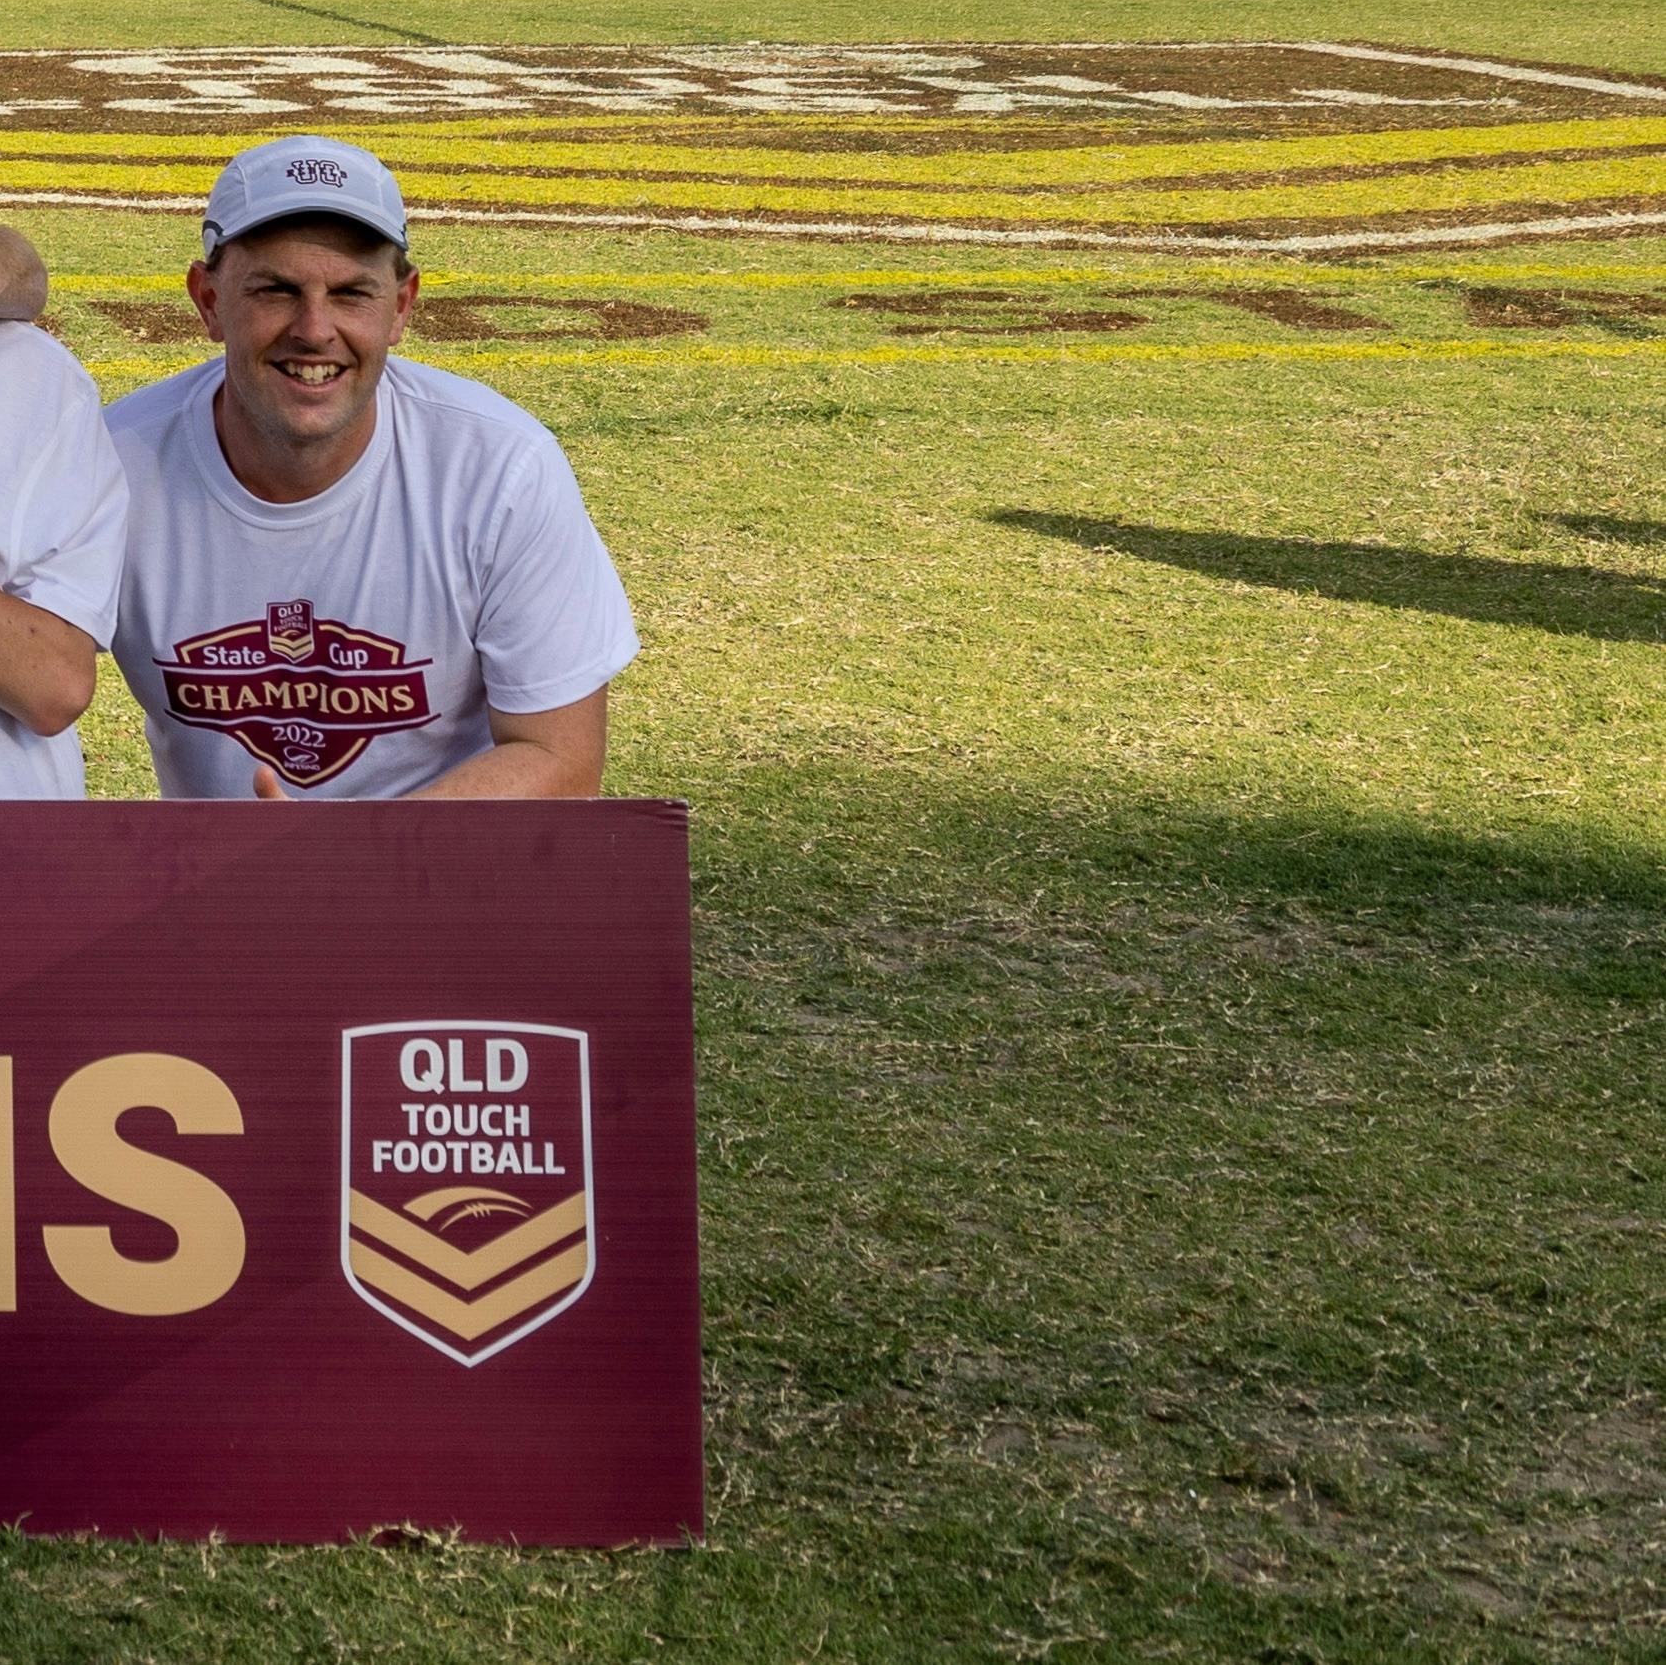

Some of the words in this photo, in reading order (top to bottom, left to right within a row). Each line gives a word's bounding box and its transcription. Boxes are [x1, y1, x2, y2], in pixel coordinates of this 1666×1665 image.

[278, 604, 303, 618] QLD
[203, 646, 266, 665] State
[329, 643, 368, 669] Cup
[177, 681, 415, 714] CHAMPIONS
[272, 725, 326, 747] 2022
[399, 1038, 529, 1095] QLD
[400, 1104, 530, 1137] TOUCH
[372, 1140, 566, 1175] FOOTBALL
